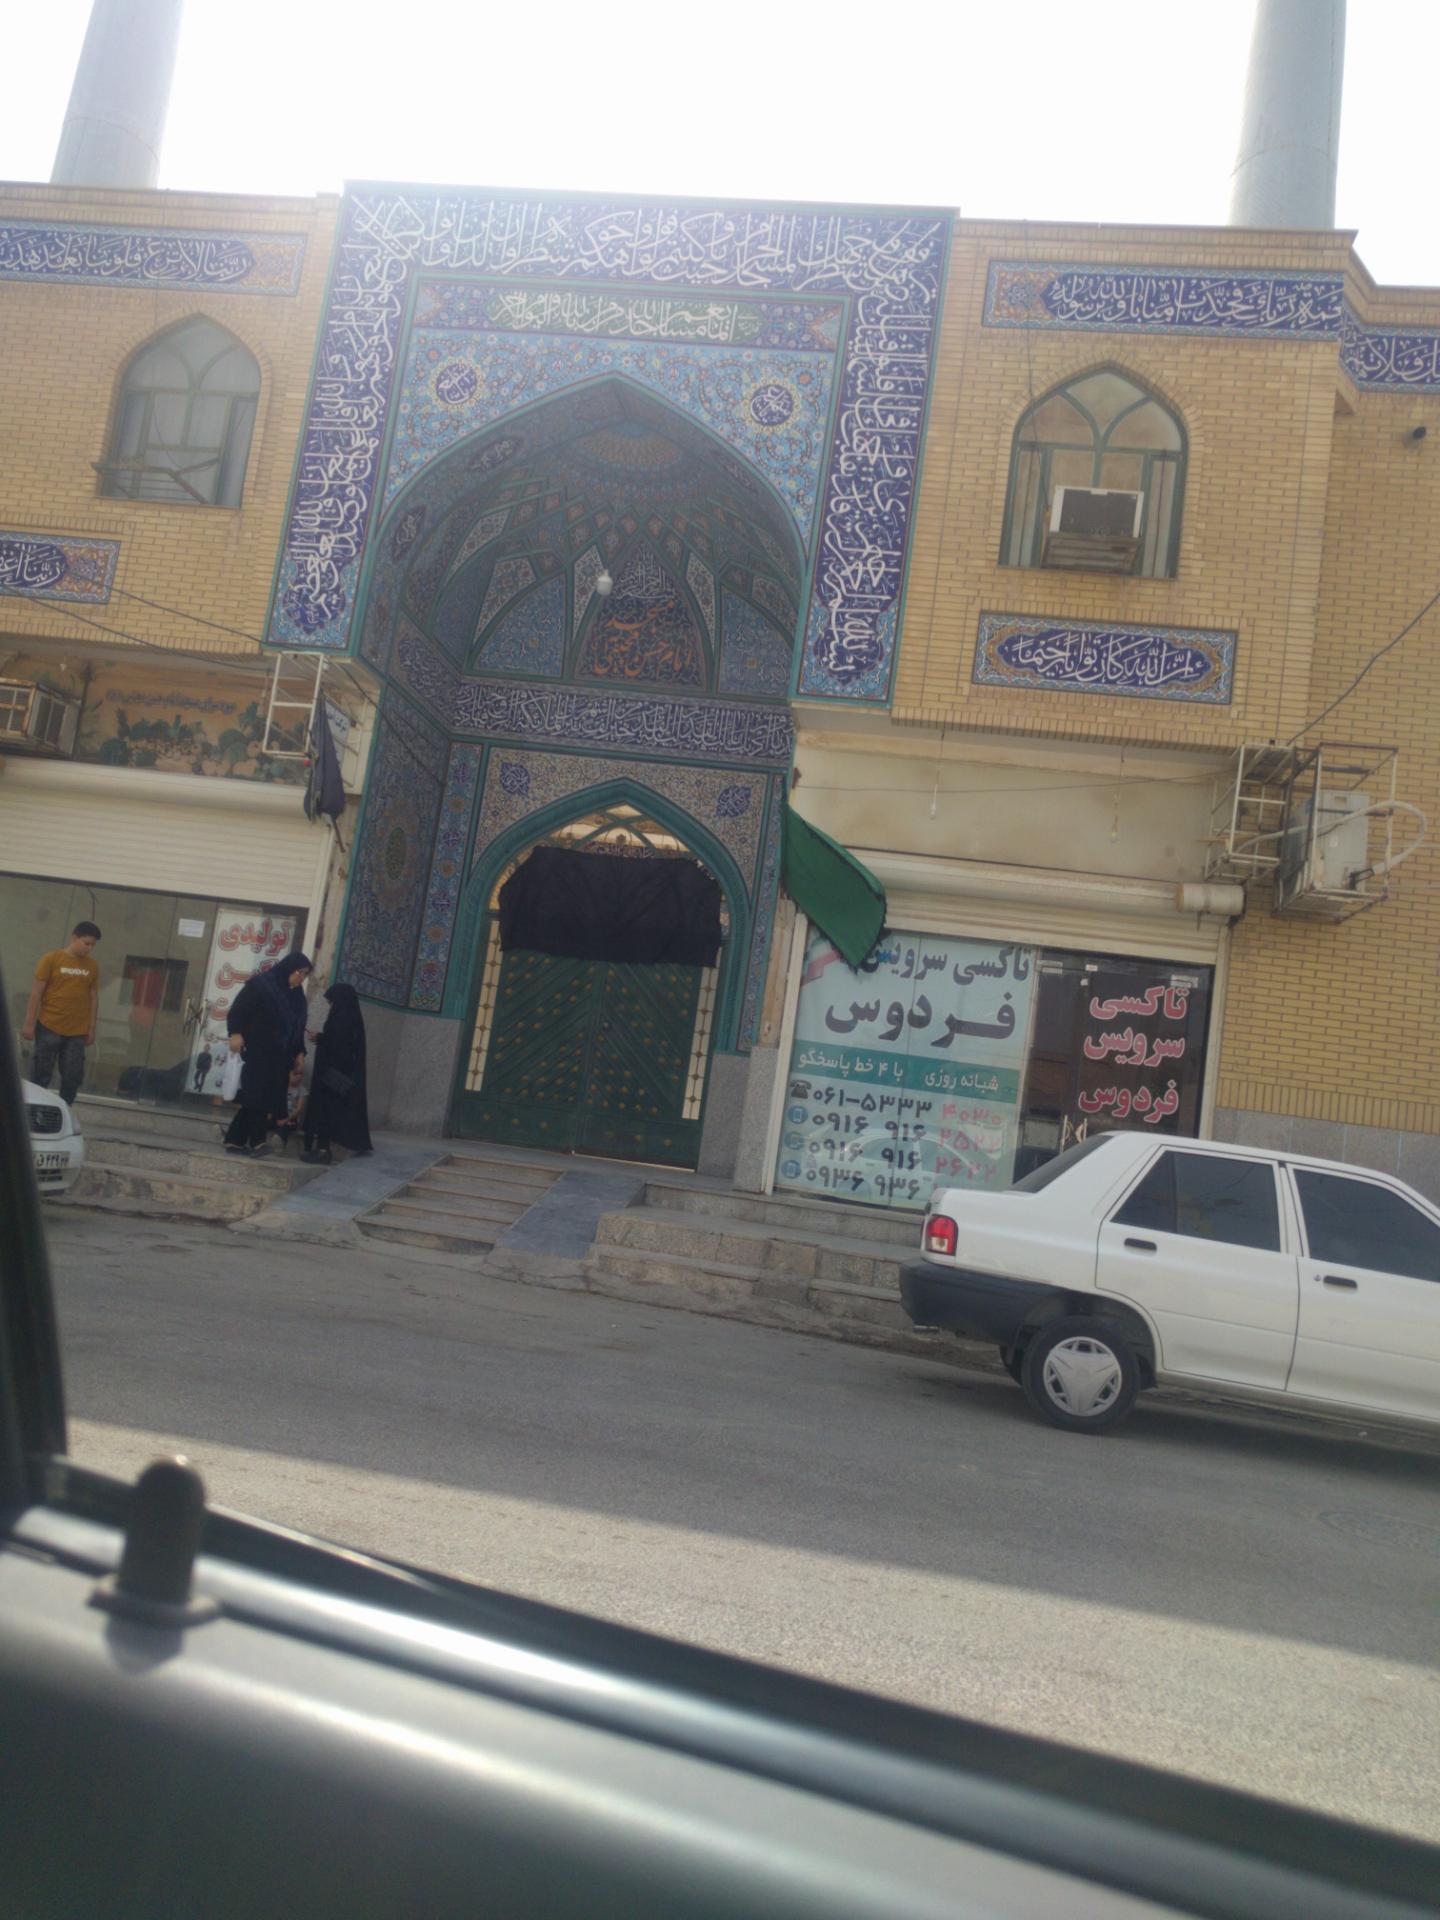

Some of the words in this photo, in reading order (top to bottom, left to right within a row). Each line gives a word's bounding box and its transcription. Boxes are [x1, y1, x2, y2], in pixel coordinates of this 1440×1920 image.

[219, 919, 294, 957] تولیدی
[860, 942, 948, 981] سرویس
[953, 945, 1031, 986] تاکسی
[825, 991, 1016, 1049] فردوس
[1089, 985, 1190, 1020] تاکسی
[798, 1047, 850, 1077] پاسخگو
[854, 1057, 874, 1073] خط
[1084, 1027, 1186, 1068] سرویس
[893, 1063, 904, 1082] با
[925, 1069, 957, 1089] روزی
[961, 1073, 999, 1092] شبانه
[1078, 1079, 1180, 1124] فردوس
